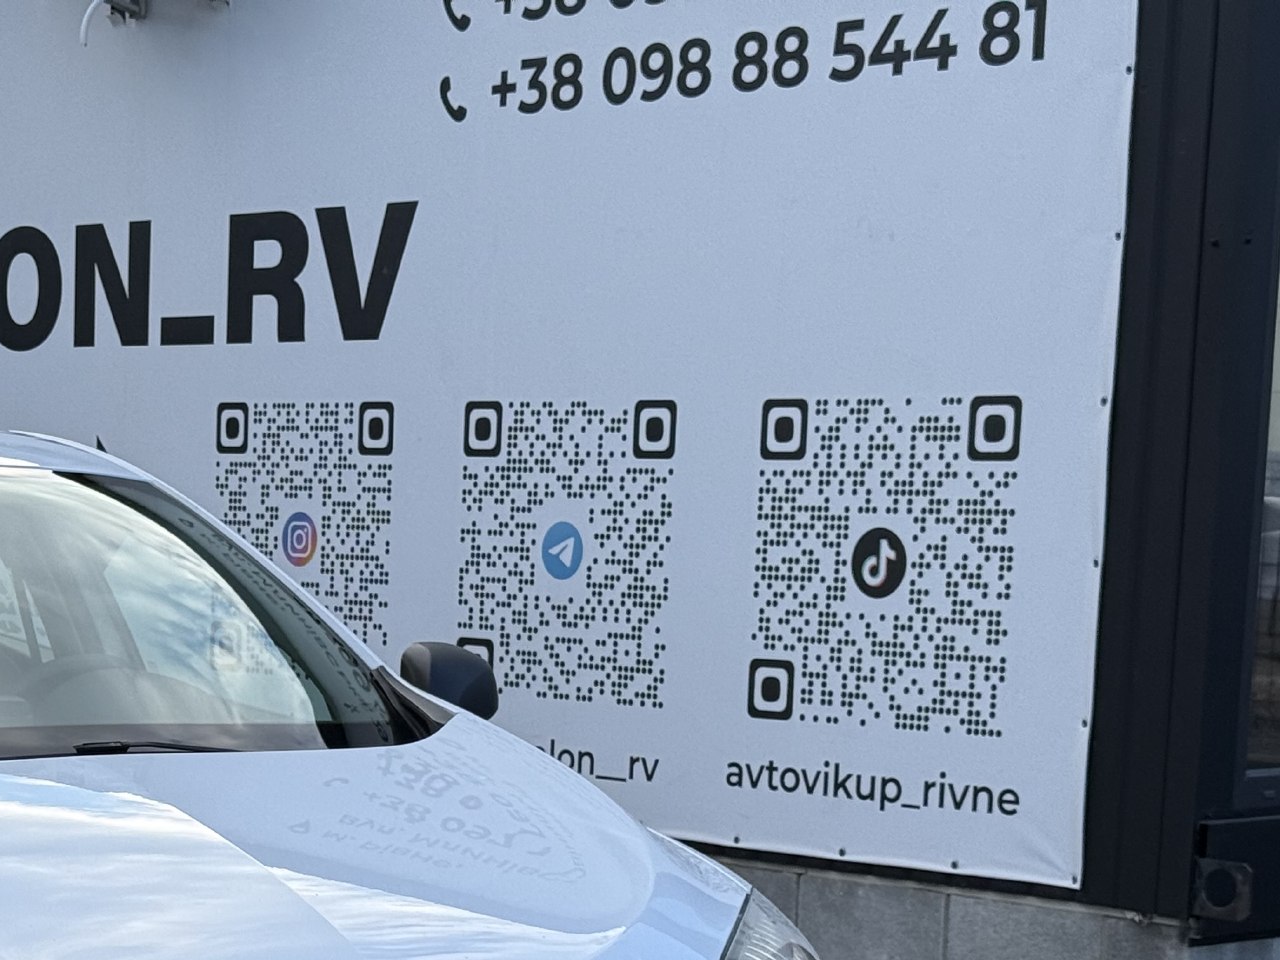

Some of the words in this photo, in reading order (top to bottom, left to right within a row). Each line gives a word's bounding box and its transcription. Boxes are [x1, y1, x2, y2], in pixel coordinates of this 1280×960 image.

[491, 53, 584, 114] +38
[602, 38, 711, 105] 098
[732, 26, 809, 92] 88
[828, 8, 958, 82] 544
[979, 0, 1047, 66] 81
[536, 739, 659, 783] lon_rv
[725, 760, 1021, 816] avtovikup_rivne
